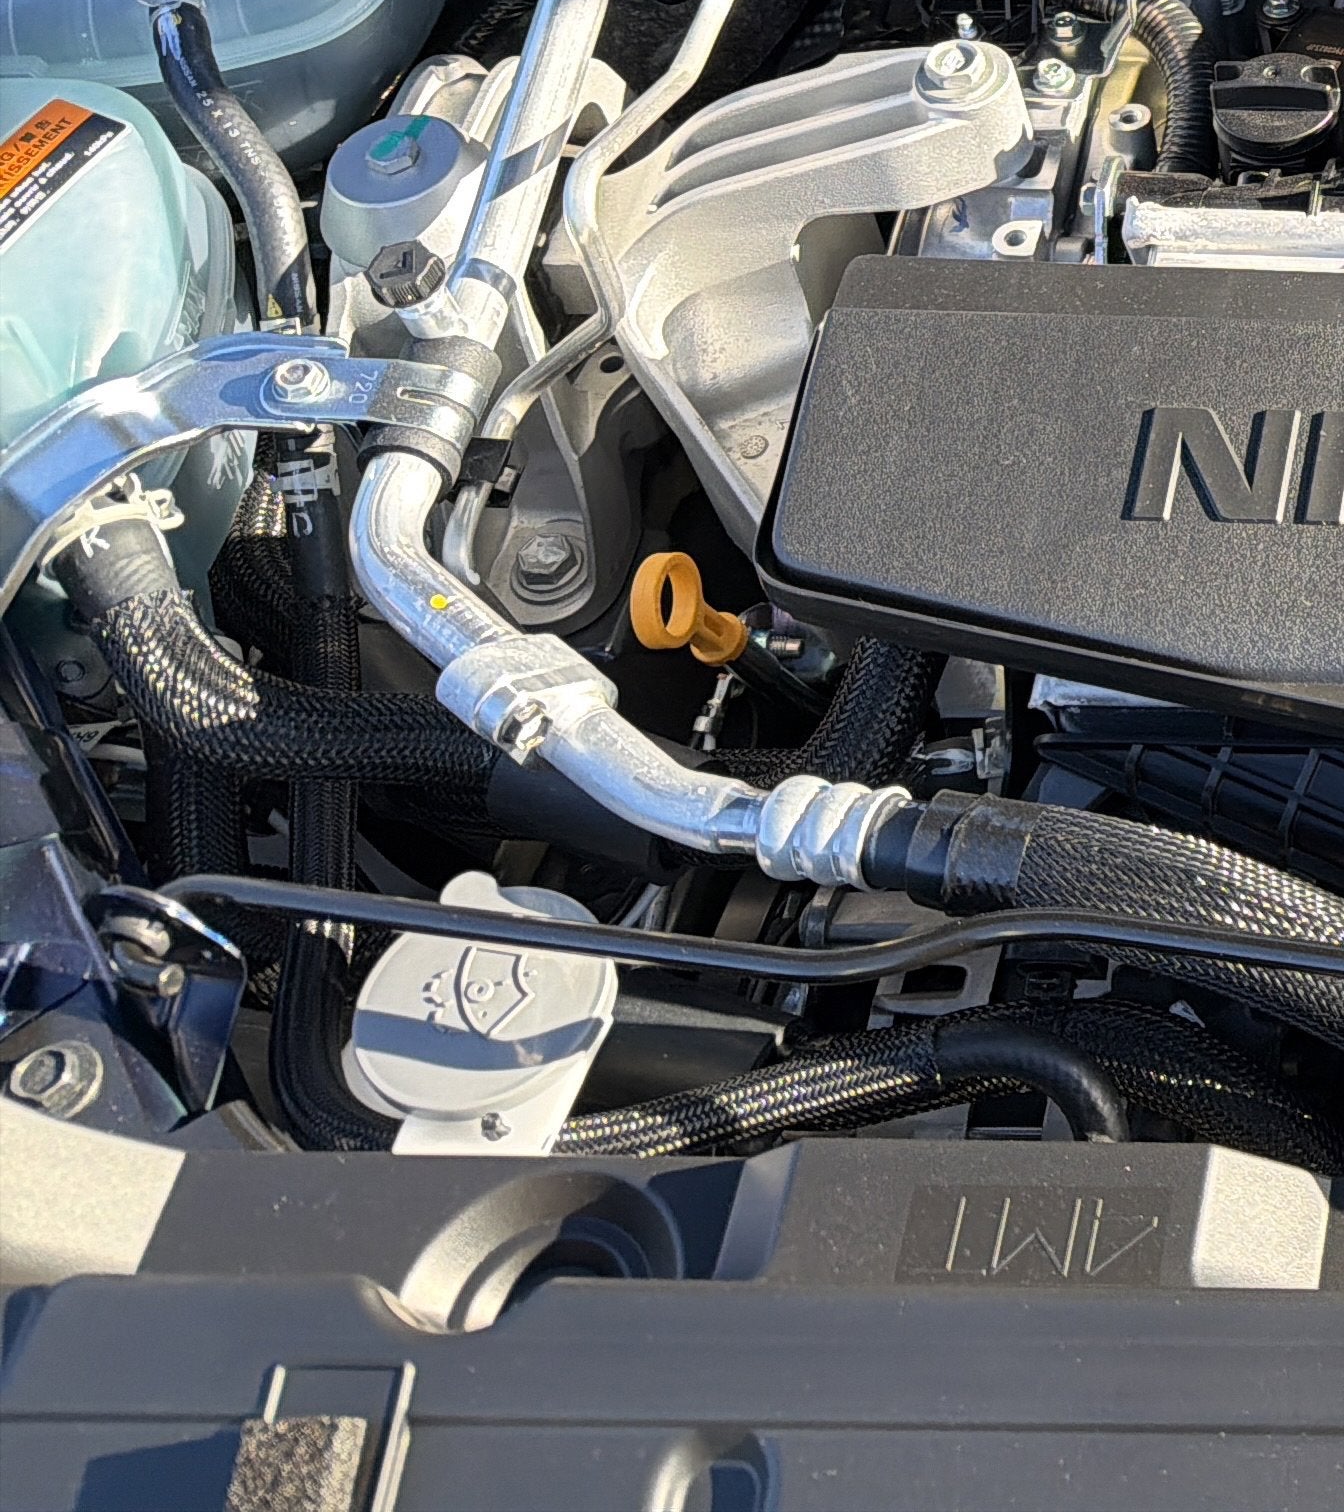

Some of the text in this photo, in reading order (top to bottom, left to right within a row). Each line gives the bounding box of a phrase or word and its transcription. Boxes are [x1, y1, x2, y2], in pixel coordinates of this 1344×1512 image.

[195, 88, 212, 111] 25
[223, 120, 240, 141] 13
[347, 369, 379, 405] 720
